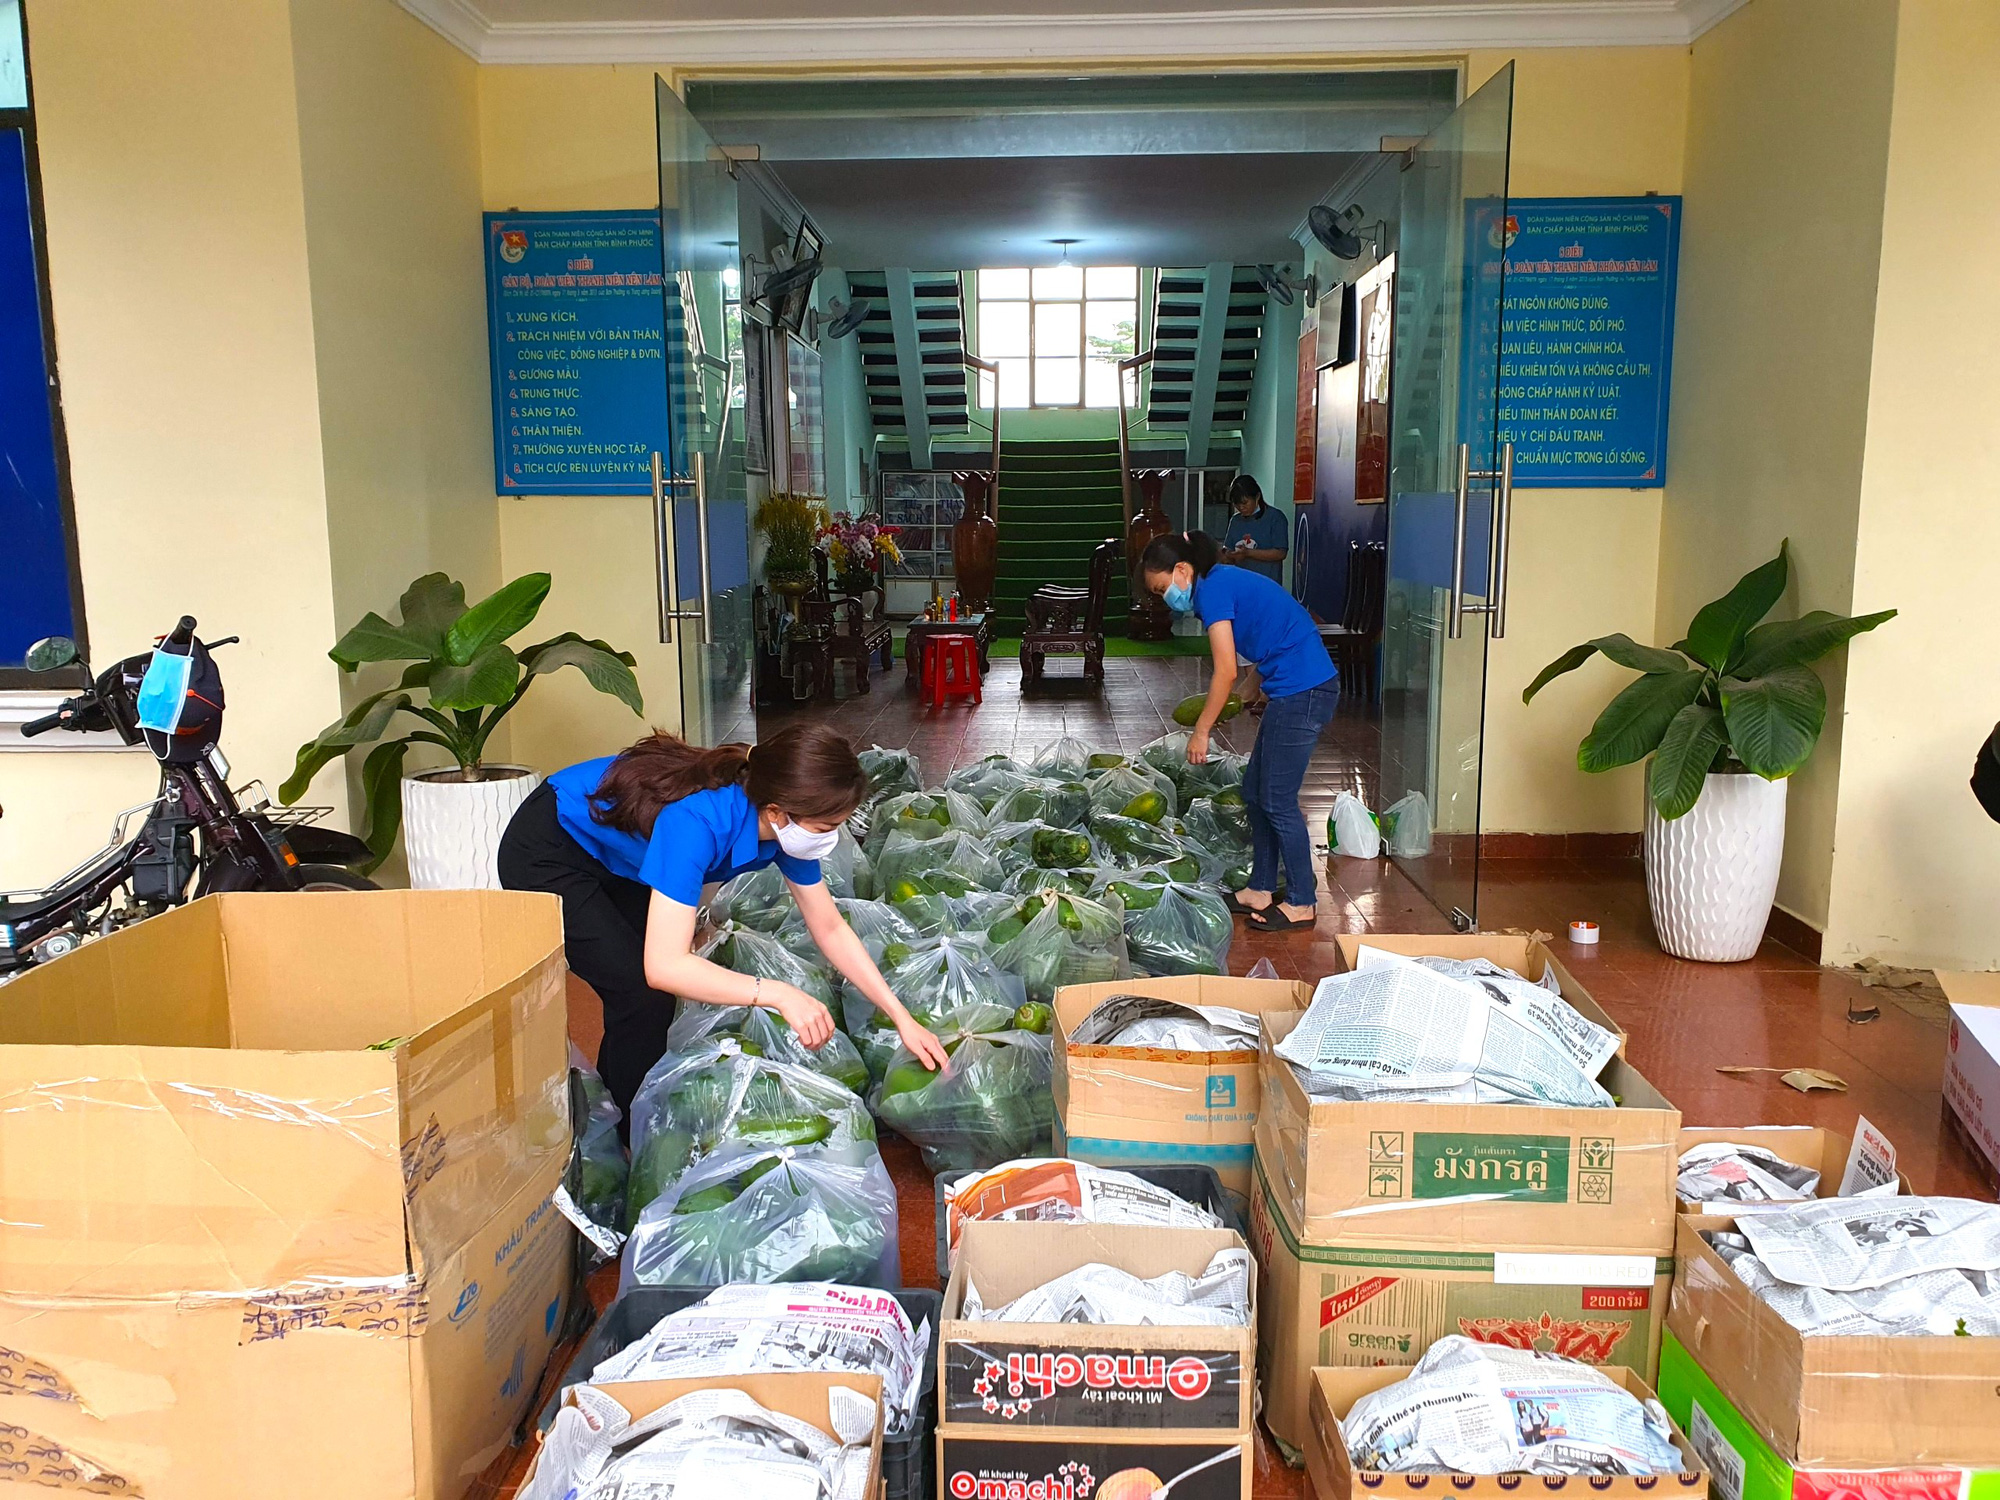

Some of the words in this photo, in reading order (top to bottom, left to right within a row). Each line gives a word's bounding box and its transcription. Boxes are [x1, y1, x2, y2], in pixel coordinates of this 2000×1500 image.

[1527, 226, 1541, 234] BAN
[1543, 225, 1563, 233] CHẤP
[534, 240, 550, 249] BAN
[1554, 261, 1578, 273] THANH
[1580, 258, 1598, 272] NIÊN
[1599, 258, 1624, 272] KHÔNG
[1625, 258, 1640, 272] NÊN
[1641, 257, 1658, 272] LÀM
[577, 274, 604, 286] THANH
[605, 272, 624, 286] NIÊN
[626, 271, 642, 286] NÊN
[644, 271, 662, 286] LÀM
[1520, 297, 1548, 310] NGÔN
[1548, 297, 1579, 310] KHÔNG
[1582, 294, 1610, 310] ĐÚNG.
[516, 312, 548, 322] XUNG
[551, 310, 579, 322] KÍCH.
[1516, 317, 1536, 334] VIỆC
[1562, 316, 1586, 333] THỨC,
[1589, 314, 1605, 332] ĐỐI
[517, 329, 550, 340] TRÁCH
[552, 328, 586, 342] NHIỆM
[588, 327, 606, 340] VỚI
[609, 326, 630, 340] BẢN
[632, 327, 662, 341] THÂN,
[518, 348, 544, 360] CÔNG
[570, 346, 595, 359] ĐỒNG
[598, 348, 628, 361] NGHIỆP
[631, 350, 636, 359] &
[638, 348, 662, 359] ĐVTN.
[1523, 339, 1544, 355] LIÊU,
[1547, 339, 1571, 354] HÀNH
[1574, 338, 1601, 353] CHÍNH
[1604, 338, 1625, 353] HÓA.
[519, 370, 554, 380] GƯƠNG
[1520, 361, 1546, 376] KHIÊM
[1549, 360, 1565, 376] TỐN
[1568, 362, 1580, 376] VÀ
[1583, 361, 1614, 376] KHÔNG
[1638, 363, 1653, 378] THỊ.
[520, 389, 550, 399] TRUNG
[553, 388, 583, 400] THỰC.
[1527, 382, 1553, 398] CHẤP
[1554, 384, 1581, 398] HÀNH
[1583, 381, 1595, 397] KỶ
[1598, 384, 1621, 400] LUẬT.
[521, 404, 552, 417] SÁNG
[554, 407, 579, 419] TẠO.
[1520, 408, 1540, 420] TINH
[1543, 403, 1567, 420] THẦN
[1570, 404, 1598, 420] ĐOÀN
[1600, 404, 1619, 420] KẾT.
[522, 424, 549, 436] THÂN
[552, 424, 584, 437] THIỆN.
[1521, 427, 1527, 441] Ý
[1530, 427, 1547, 441] CHÍ
[1550, 424, 1570, 441] ĐẤU
[1573, 431, 1606, 441] TRANH.
[523, 442, 564, 455] THƯỜNG
[566, 442, 602, 454] XUYÊN
[604, 444, 626, 456] HỌC
[629, 442, 650, 456] TẬP.
[1516, 446, 1548, 463] CHUẨN
[1550, 451, 1572, 466] MỰC
[1574, 452, 1603, 463] TRONG
[1605, 447, 1618, 463] LỐI
[1620, 447, 1648, 463] SỐNG.
[524, 461, 543, 473] TÍCH
[546, 462, 568, 474] CỰC
[570, 460, 588, 472] RÈN
[590, 460, 621, 474] LUYỆN
[1528, 1009, 1551, 1030] Covid-19
[1434, 1147, 1548, 1190] มังกรคู่
[1616, 1266, 1648, 1278] RED
[1330, 1286, 1360, 1317] ใหม่
[1590, 1296, 1615, 1307] 200
[1617, 1291, 1642, 1307] กรัม
[1348, 1332, 1395, 1347] green
[1360, 1343, 1395, 1351] CARTON
[1007, 1352, 1212, 1401] Omachi
[1082, 1389, 1103, 1403] tây
[1105, 1389, 1143, 1404] khoai
[1146, 1391, 1163, 1404] Mì
[1392, 1408, 1409, 1422] thế
[1409, 1403, 1421, 1413] và
[979, 1469, 989, 1478] Mì
[990, 1469, 1011, 1478] khoai
[1012, 1471, 1029, 1480] tây
[950, 1473, 1074, 1500] Omachi
